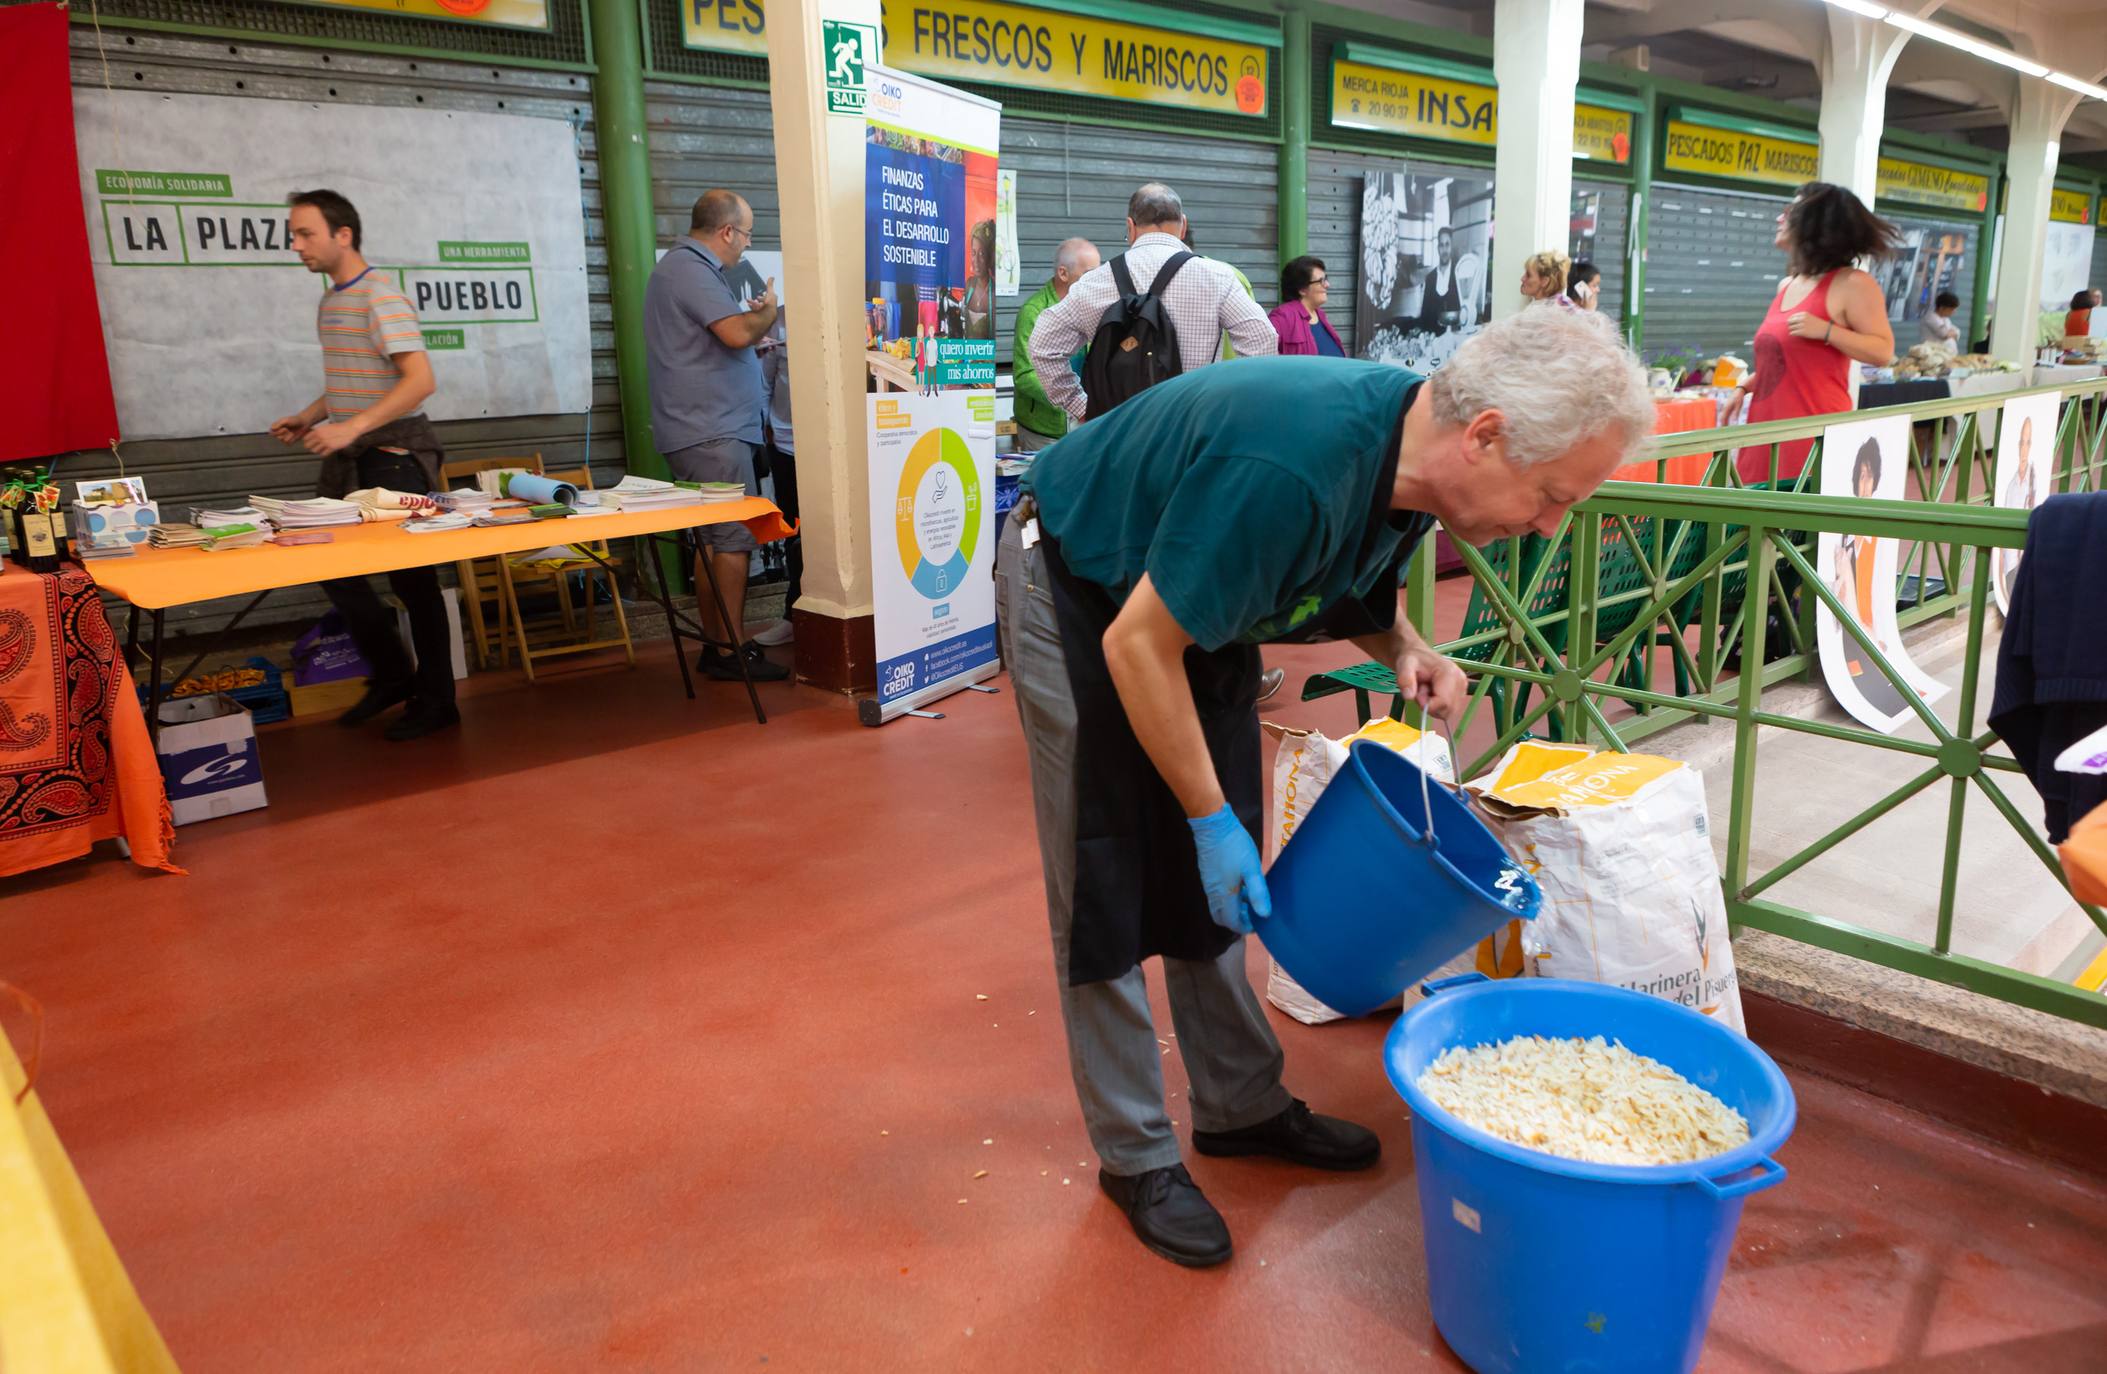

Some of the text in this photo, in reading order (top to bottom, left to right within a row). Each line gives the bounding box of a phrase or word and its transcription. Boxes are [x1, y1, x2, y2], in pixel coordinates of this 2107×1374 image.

[912, 7, 1053, 73] FRESCOS
[1070, 31, 1087, 77] Y
[1103, 37, 1229, 97] MARISCOS
[881, 83, 903, 100] OIKO
[1342, 75, 1409, 99] MERCA RIOJA
[833, 91, 867, 109] SALID
[1417, 88, 1499, 133] INSA
[1668, 133, 1734, 165] PESCADOS
[1737, 139, 1762, 172] PAZ
[105, 175, 225, 193] ECONOMÍA SOLIDARIA
[882, 165, 924, 191] FINANZAS
[882, 189, 939, 218] ÉTICAS PARA
[123, 216, 168, 251] LA
[883, 218, 950, 245] EL DESARROLLO
[443, 246, 527, 258] UNA HERRAMIENTA
[883, 244, 937, 267] SOSTENIBLE
[415, 280, 523, 312] PUEBLO
[425, 331, 459, 346] LACIÓN
[939, 339, 995, 360] quiero invertir
[947, 364, 995, 380] mis ahorros
[893, 661, 915, 679] OIKO
[883, 674, 915, 697] CREDIT
[1673, 986, 1700, 1007] del
